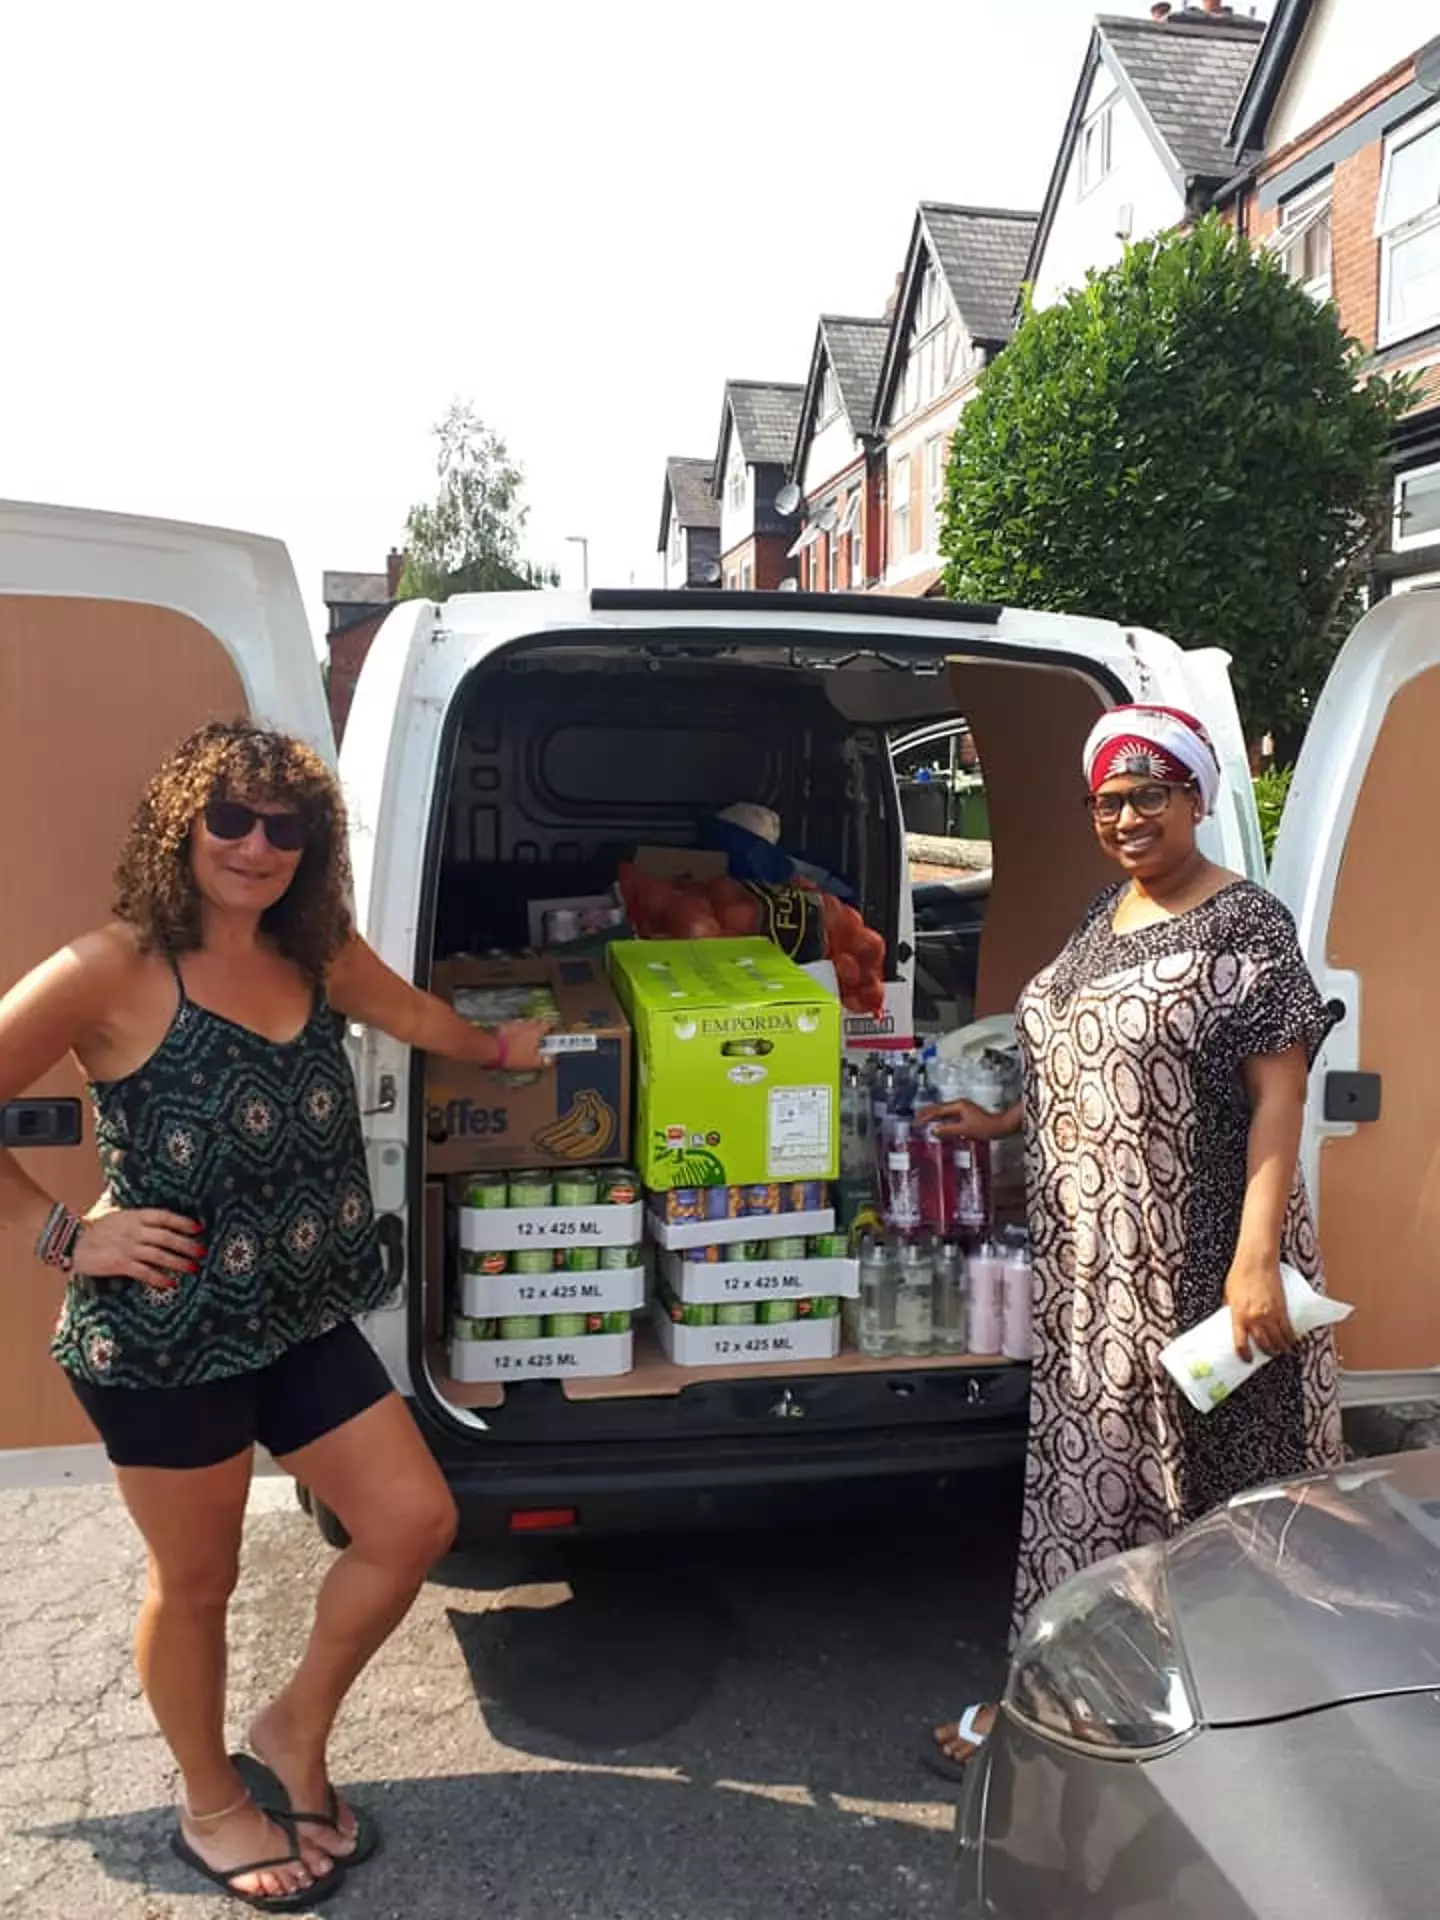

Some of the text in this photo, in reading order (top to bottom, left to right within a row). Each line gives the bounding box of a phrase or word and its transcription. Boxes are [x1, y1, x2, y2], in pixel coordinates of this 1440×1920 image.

[444, 1098, 508, 1137] ffes
[516, 1221, 602, 1235] 12 x 425 ML
[725, 1275, 804, 1290] 12 x 425 ML
[518, 1284, 603, 1299] 12 x 425 ML
[715, 1337, 794, 1353] 12 x 425 ML
[495, 1352, 578, 1368] 12 x 425 ML
